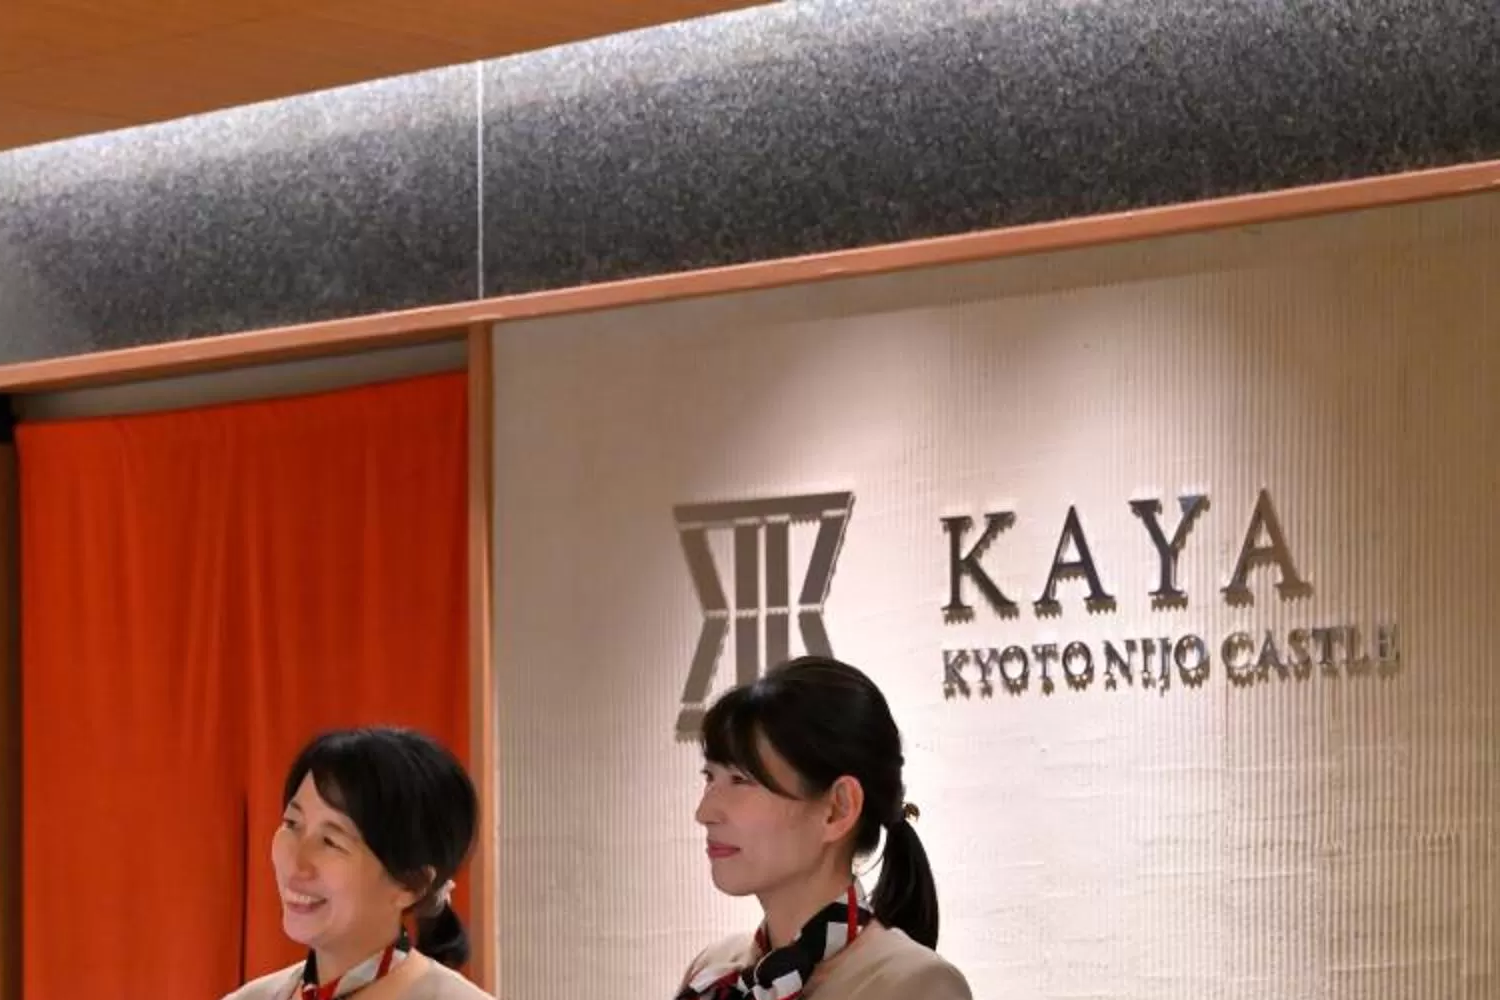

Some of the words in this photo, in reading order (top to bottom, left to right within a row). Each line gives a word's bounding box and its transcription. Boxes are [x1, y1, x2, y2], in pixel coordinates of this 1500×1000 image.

[940, 488, 1313, 620] KAYA
[942, 640, 1094, 698] KYOTO
[1103, 634, 1210, 696] NIJO
[1221, 623, 1401, 687] CASTLE
